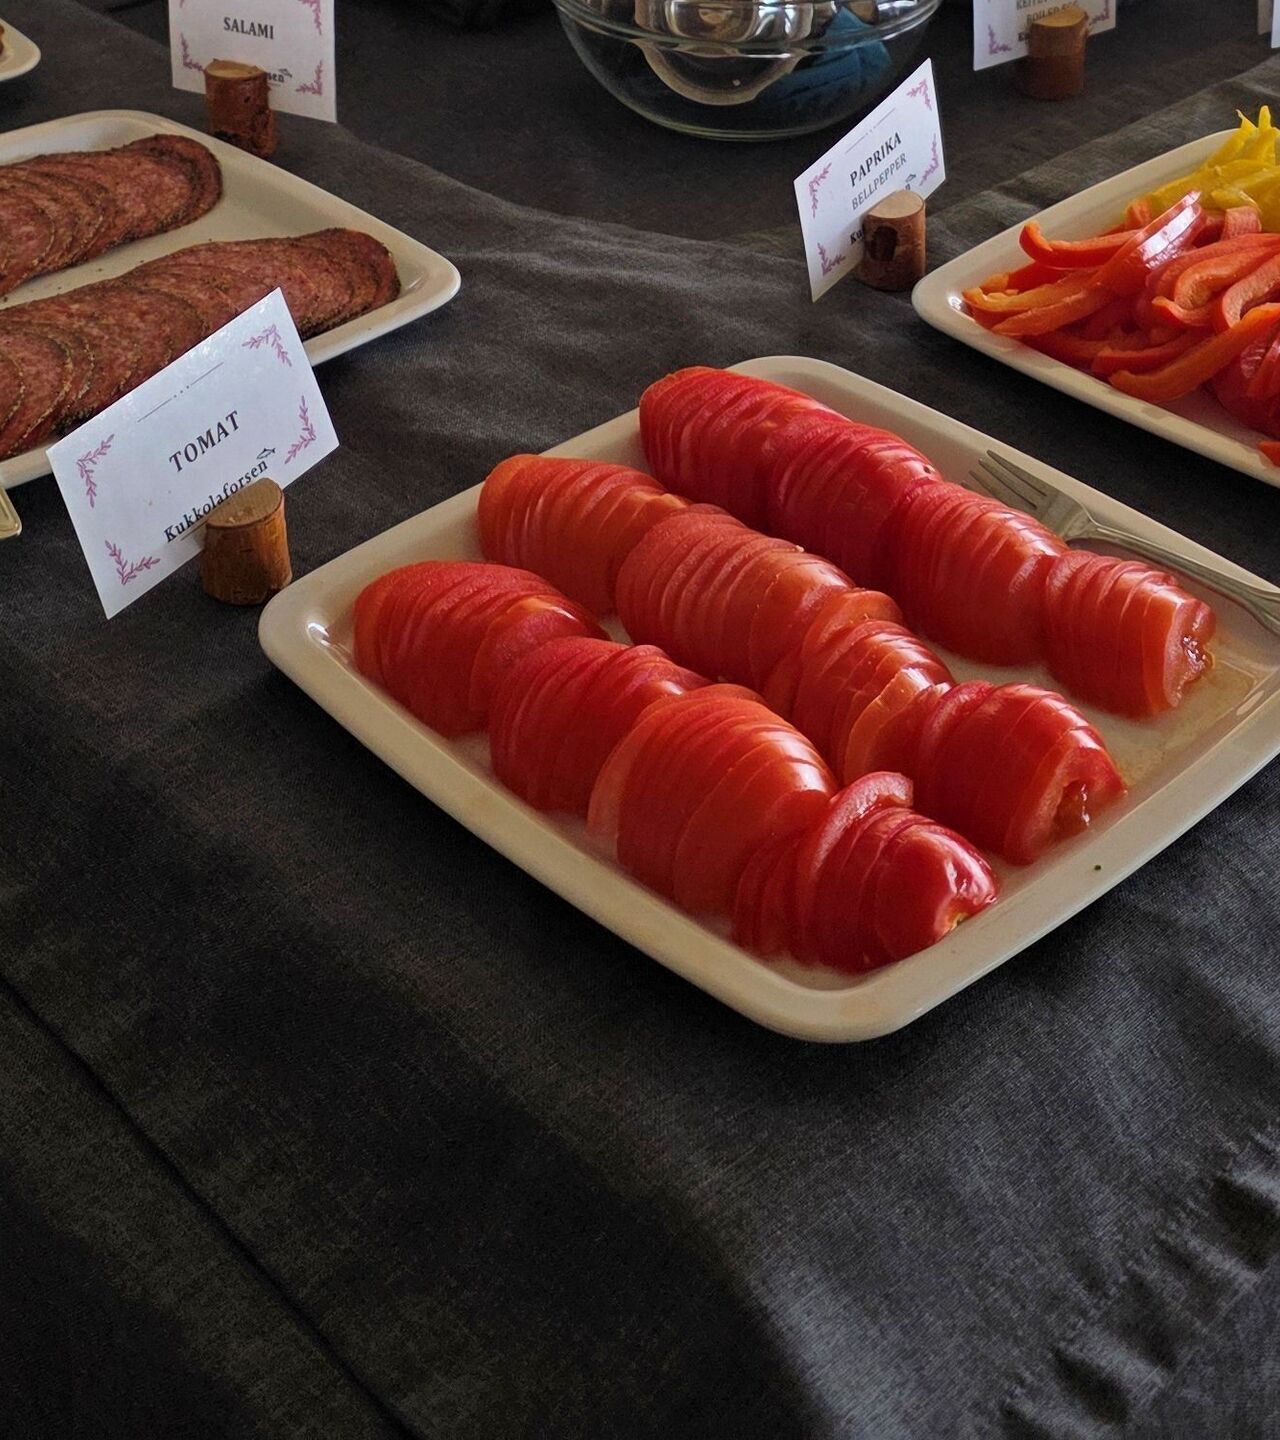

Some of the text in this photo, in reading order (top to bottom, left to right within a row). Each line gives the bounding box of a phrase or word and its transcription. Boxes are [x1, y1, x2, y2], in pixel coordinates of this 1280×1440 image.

[223, 16, 274, 40] SALAMI
[849, 131, 902, 188] PAPRIKA
[852, 153, 908, 210] BELLPEPPER
[168, 410, 239, 472] TOMAT
[163, 460, 268, 543] Kukkolaforsen
